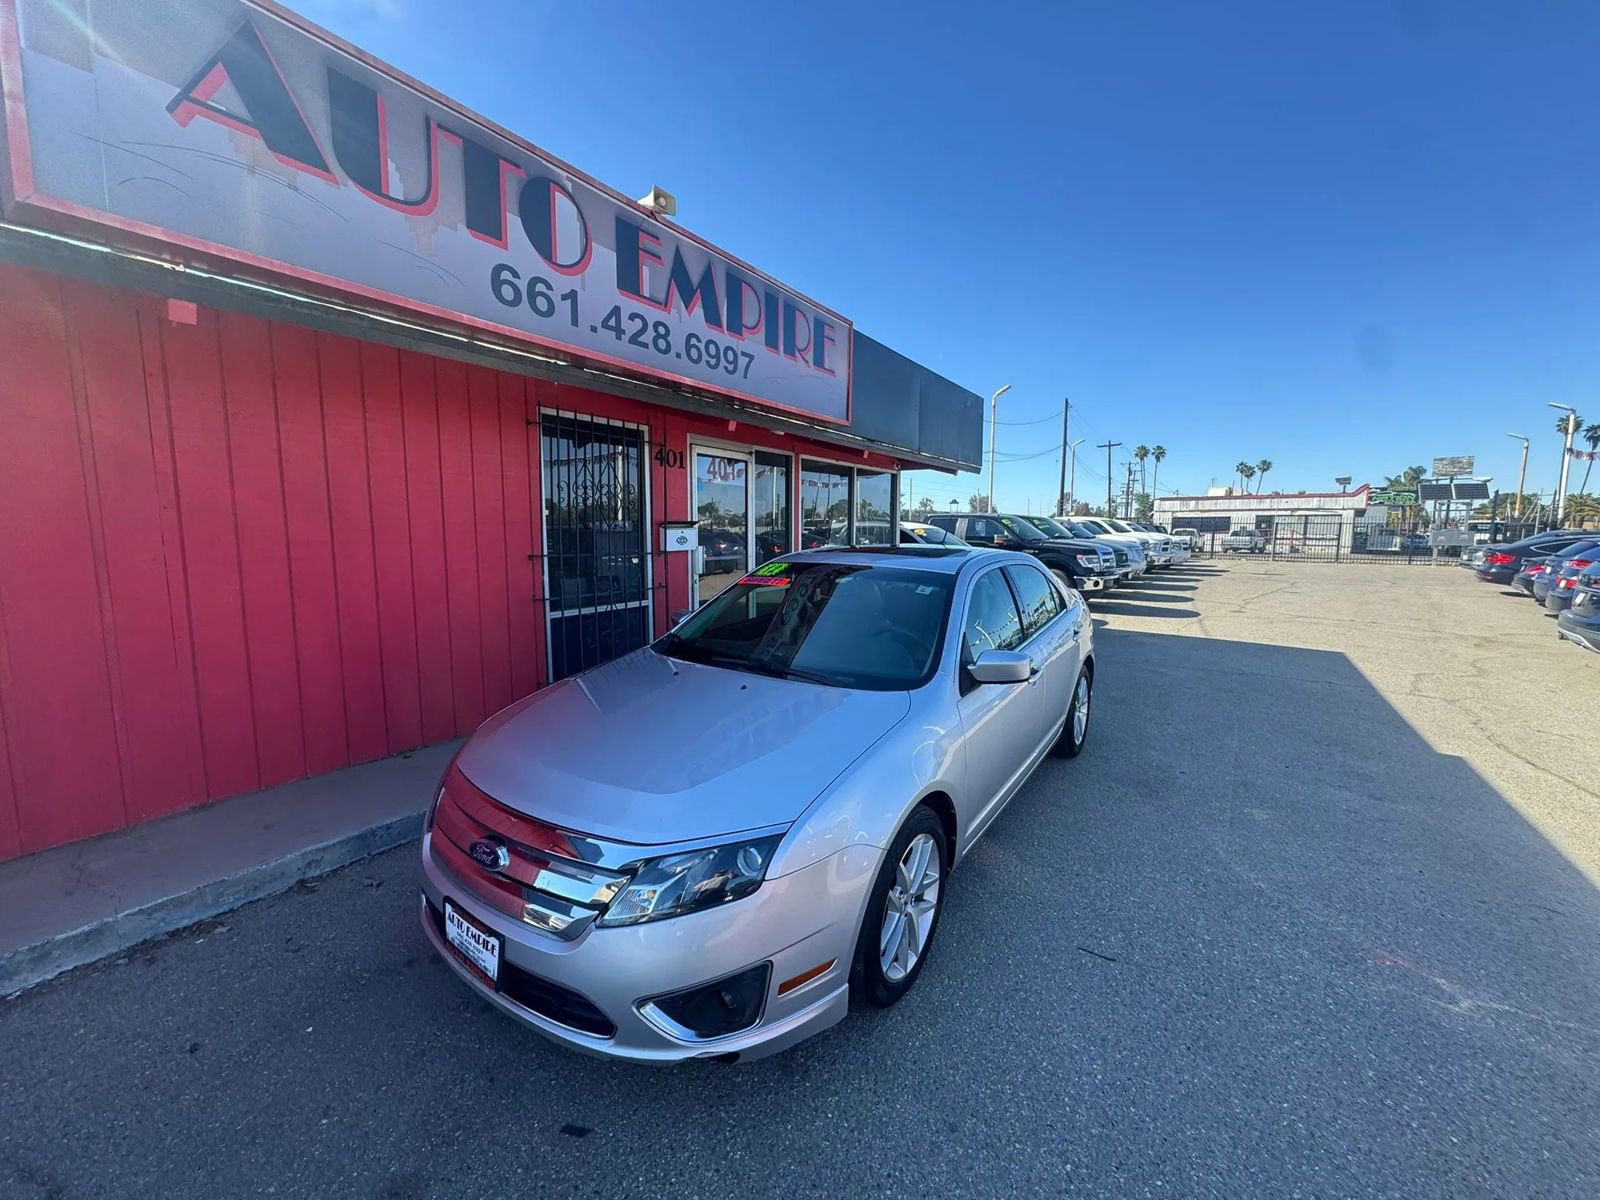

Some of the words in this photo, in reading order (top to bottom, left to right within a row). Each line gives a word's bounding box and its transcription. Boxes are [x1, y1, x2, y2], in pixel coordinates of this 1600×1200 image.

[166, 20, 592, 278] AUTO
[615, 217, 838, 379] EMPIRE
[490, 263, 756, 381] 661.428.6997
[654, 448, 686, 470] 401
[707, 457, 736, 481] 401
[472, 843, 494, 865] Ford
[447, 911, 466, 935] AUTO
[466, 926, 497, 958] EMPIRE
